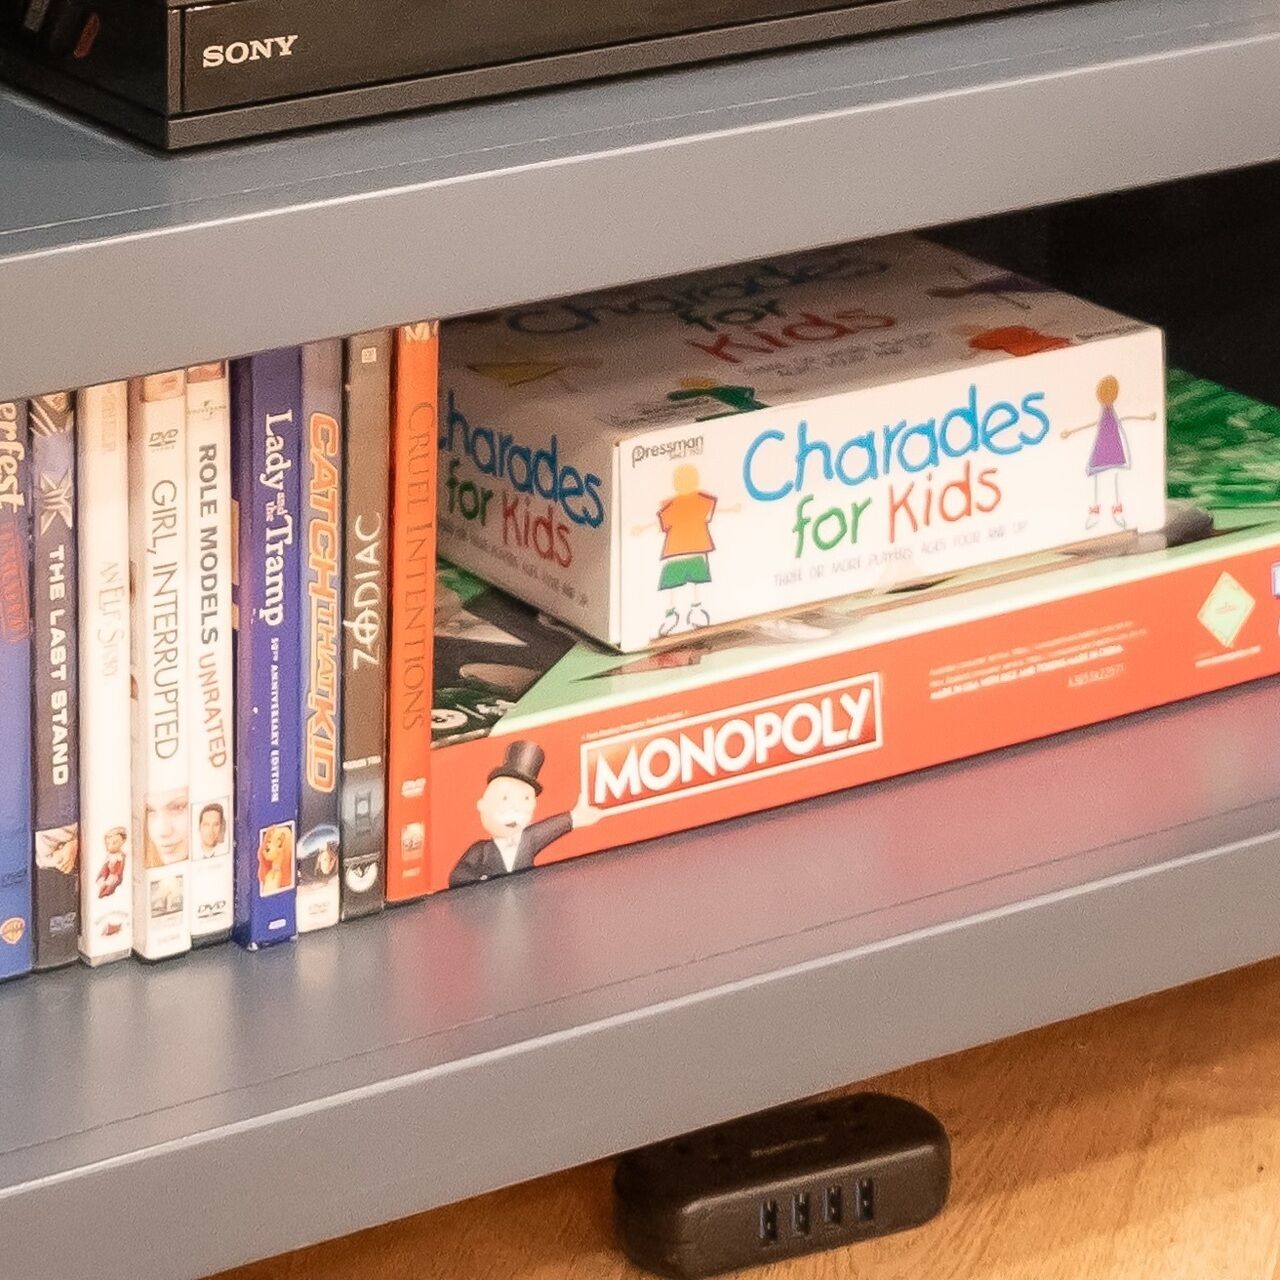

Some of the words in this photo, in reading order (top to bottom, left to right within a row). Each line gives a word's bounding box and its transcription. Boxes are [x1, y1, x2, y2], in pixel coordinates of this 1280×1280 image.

[202, 35, 299, 68] SONY
[199, 443, 218, 518] ROLE
[260, 409, 293, 490] Lady
[407, 402, 435, 515] CRUEL
[439, 389, 605, 528] harades
[743, 384, 1050, 502] Charades
[147, 479, 177, 555] GIRL,
[309, 412, 339, 602] CATCH
[446, 457, 494, 526] for
[502, 491, 572, 568] Kids
[792, 493, 872, 558] for
[888, 460, 1002, 544] Kids
[49, 544, 65, 601] THE
[200, 525, 219, 646] MODELS
[260, 514, 293, 626] Tramp
[342, 512, 381, 670] ZODIAC
[402, 521, 433, 731] INTENTIONS
[49, 609, 67, 680] LAST
[152, 562, 180, 760] INTERRUPTED
[51, 690, 68, 785] STAND
[199, 651, 227, 768] UNRATED
[594, 687, 871, 804] MONOPOLY
[271, 750, 279, 803] EDITION
